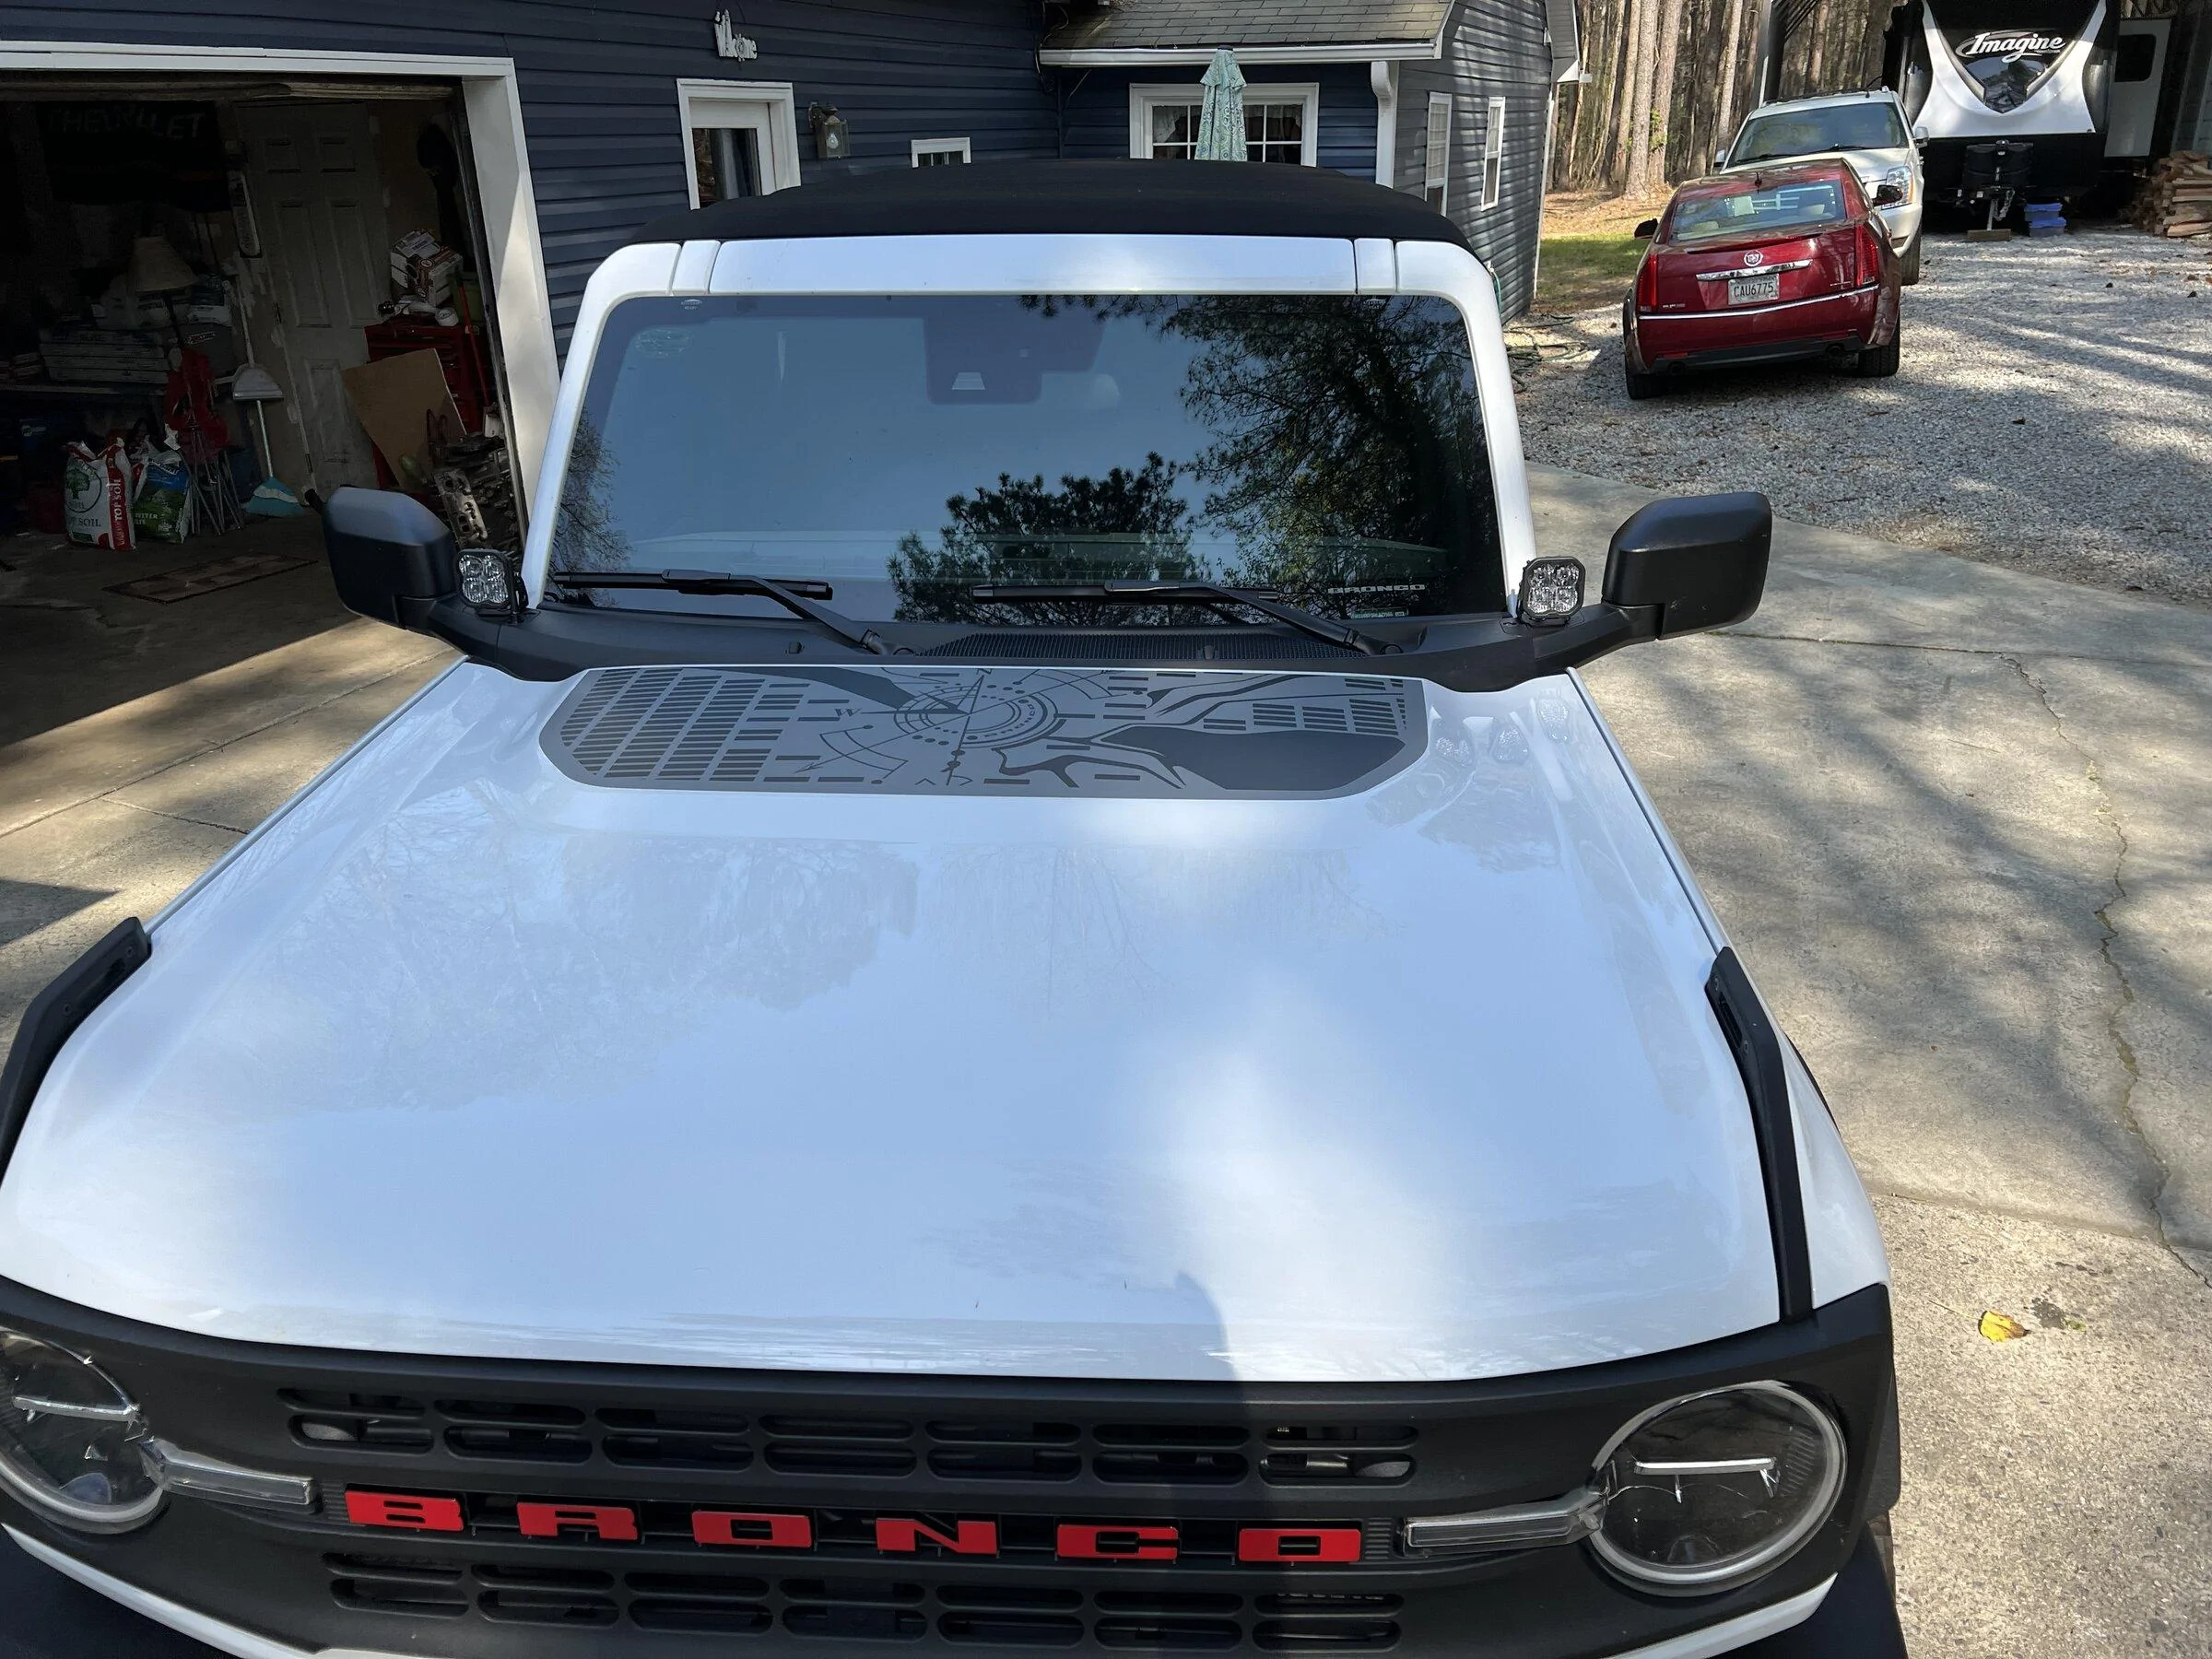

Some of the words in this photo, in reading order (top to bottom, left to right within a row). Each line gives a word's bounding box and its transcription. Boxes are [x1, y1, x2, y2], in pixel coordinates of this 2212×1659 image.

[1966, 32, 2065, 63] Imagine
[1734, 282, 1774, 297] CAU6775
[1327, 584, 1425, 594] BRONCO
[345, 1489, 1361, 1562] BRONCO
